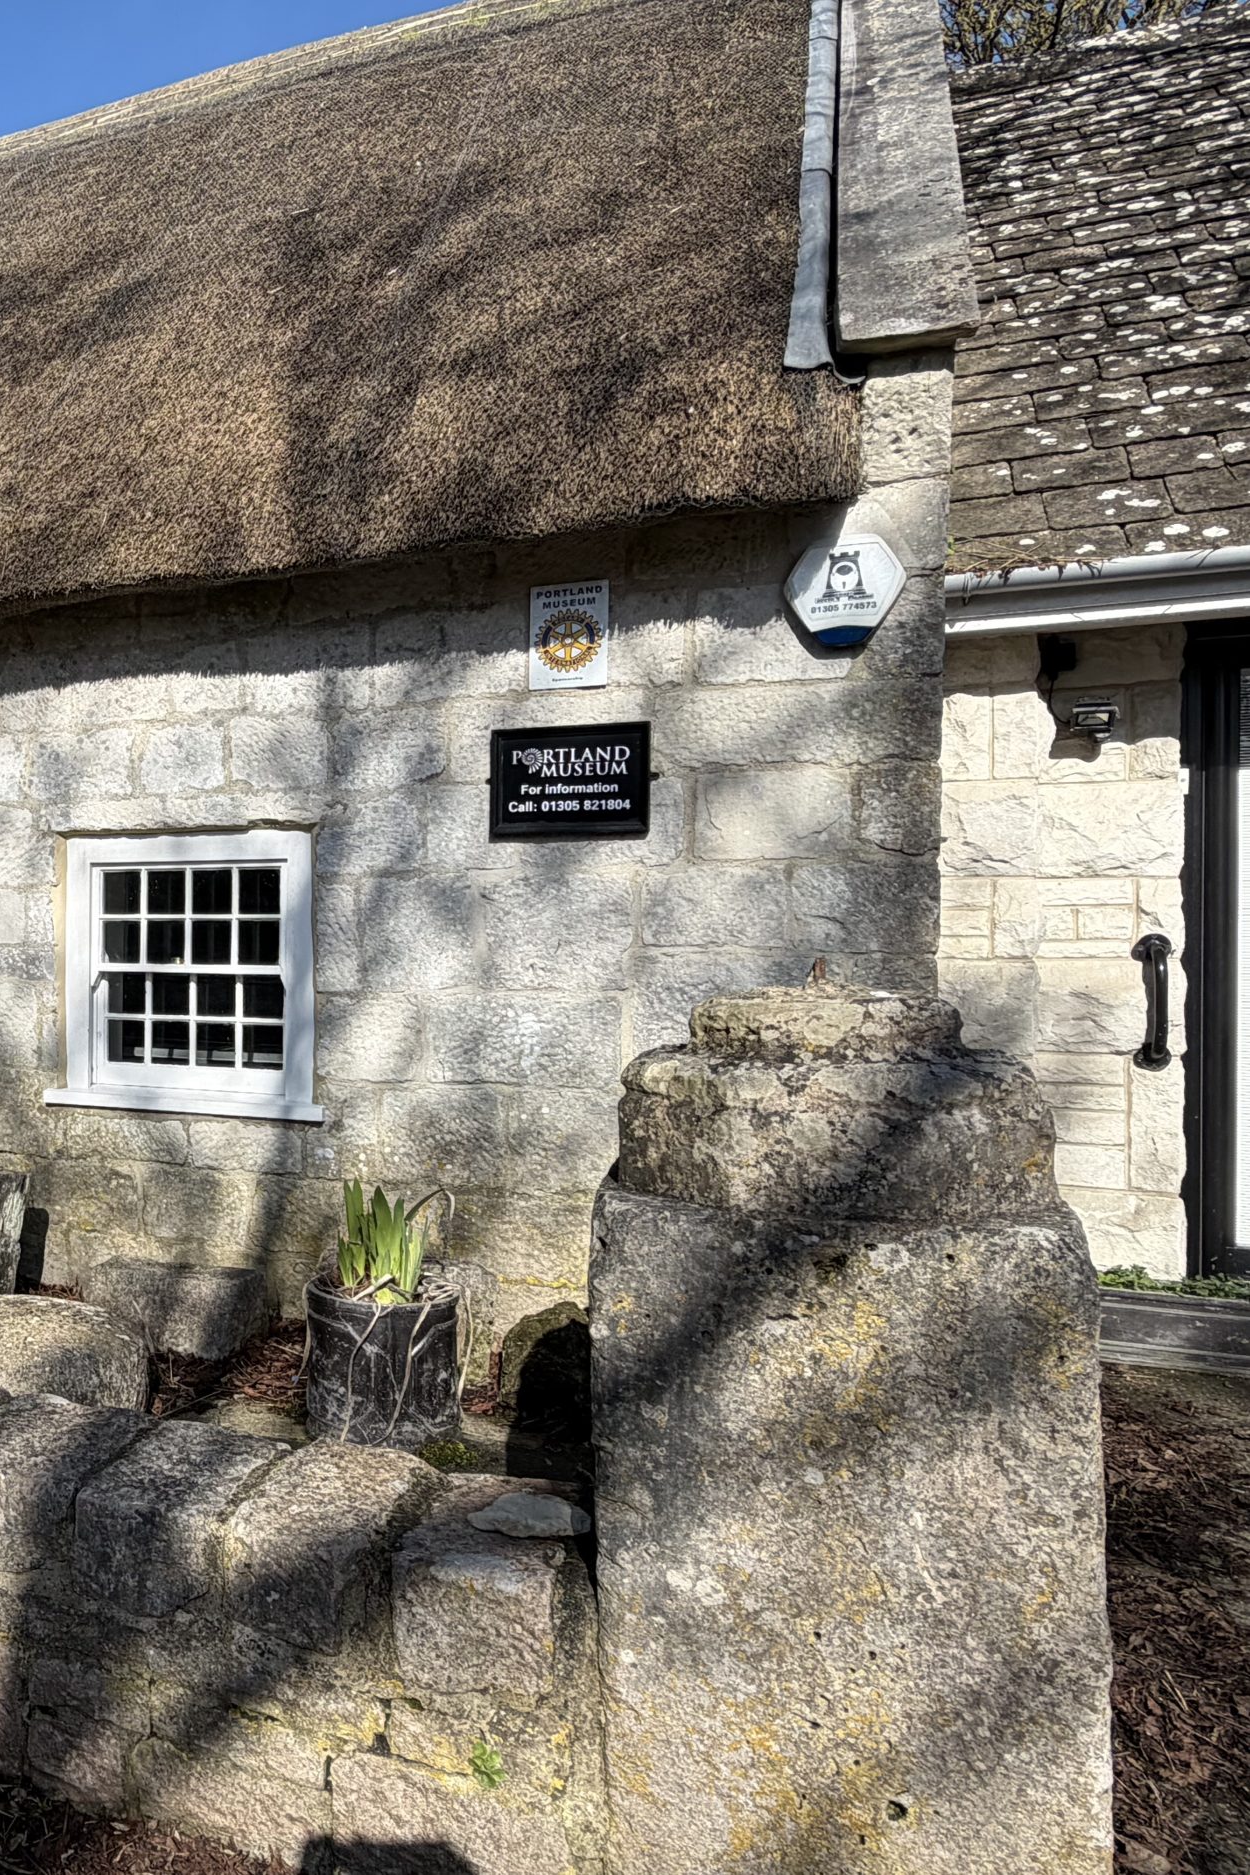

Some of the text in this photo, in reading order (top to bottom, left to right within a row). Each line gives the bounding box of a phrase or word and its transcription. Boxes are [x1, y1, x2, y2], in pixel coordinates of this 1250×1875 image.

[536, 585, 603, 599] PORTLAND
[542, 597, 596, 609] MUSEUM
[810, 601, 877, 614] 01305 774573
[511, 746, 631, 766] PORTLAND
[540, 761, 629, 777] MUSEUM
[520, 782, 619, 795] For information
[508, 799, 631, 813] Call: 01305 821804
